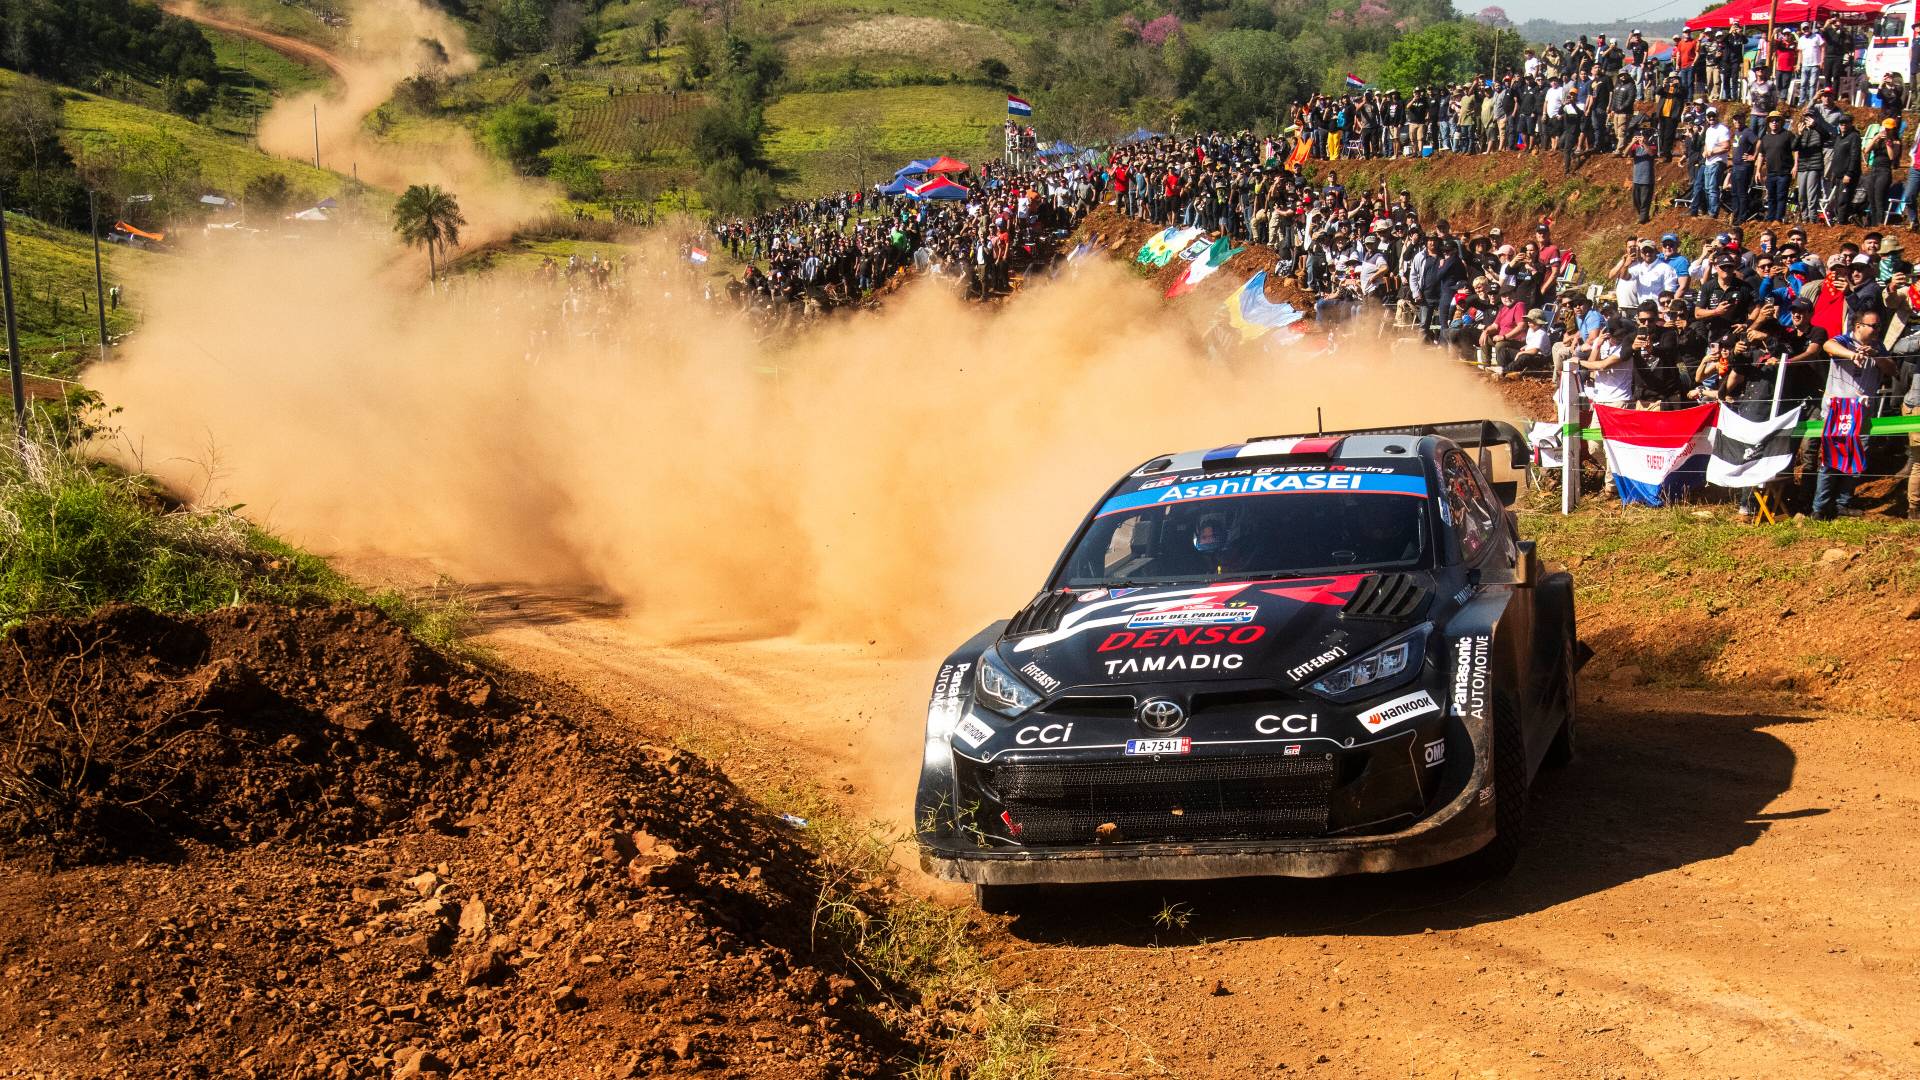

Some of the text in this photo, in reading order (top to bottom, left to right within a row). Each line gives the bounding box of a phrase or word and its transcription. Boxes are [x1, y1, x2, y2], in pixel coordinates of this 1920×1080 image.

[1751, 12, 1771, 21] DIES
[1181, 464, 1395, 482] TOYOTA GAZOO Racing
[1134, 611, 1252, 622] RALLY DEL PARAGUAY
[1097, 625, 1267, 653] DENSO
[1105, 653, 1244, 675] TAMADIC
[1450, 636, 1473, 717] Panasonic
[1471, 635, 1489, 720] AUTOMOTIVE
[1138, 740, 1178, 752] A-7541
[1425, 742, 1445, 763] OMP
